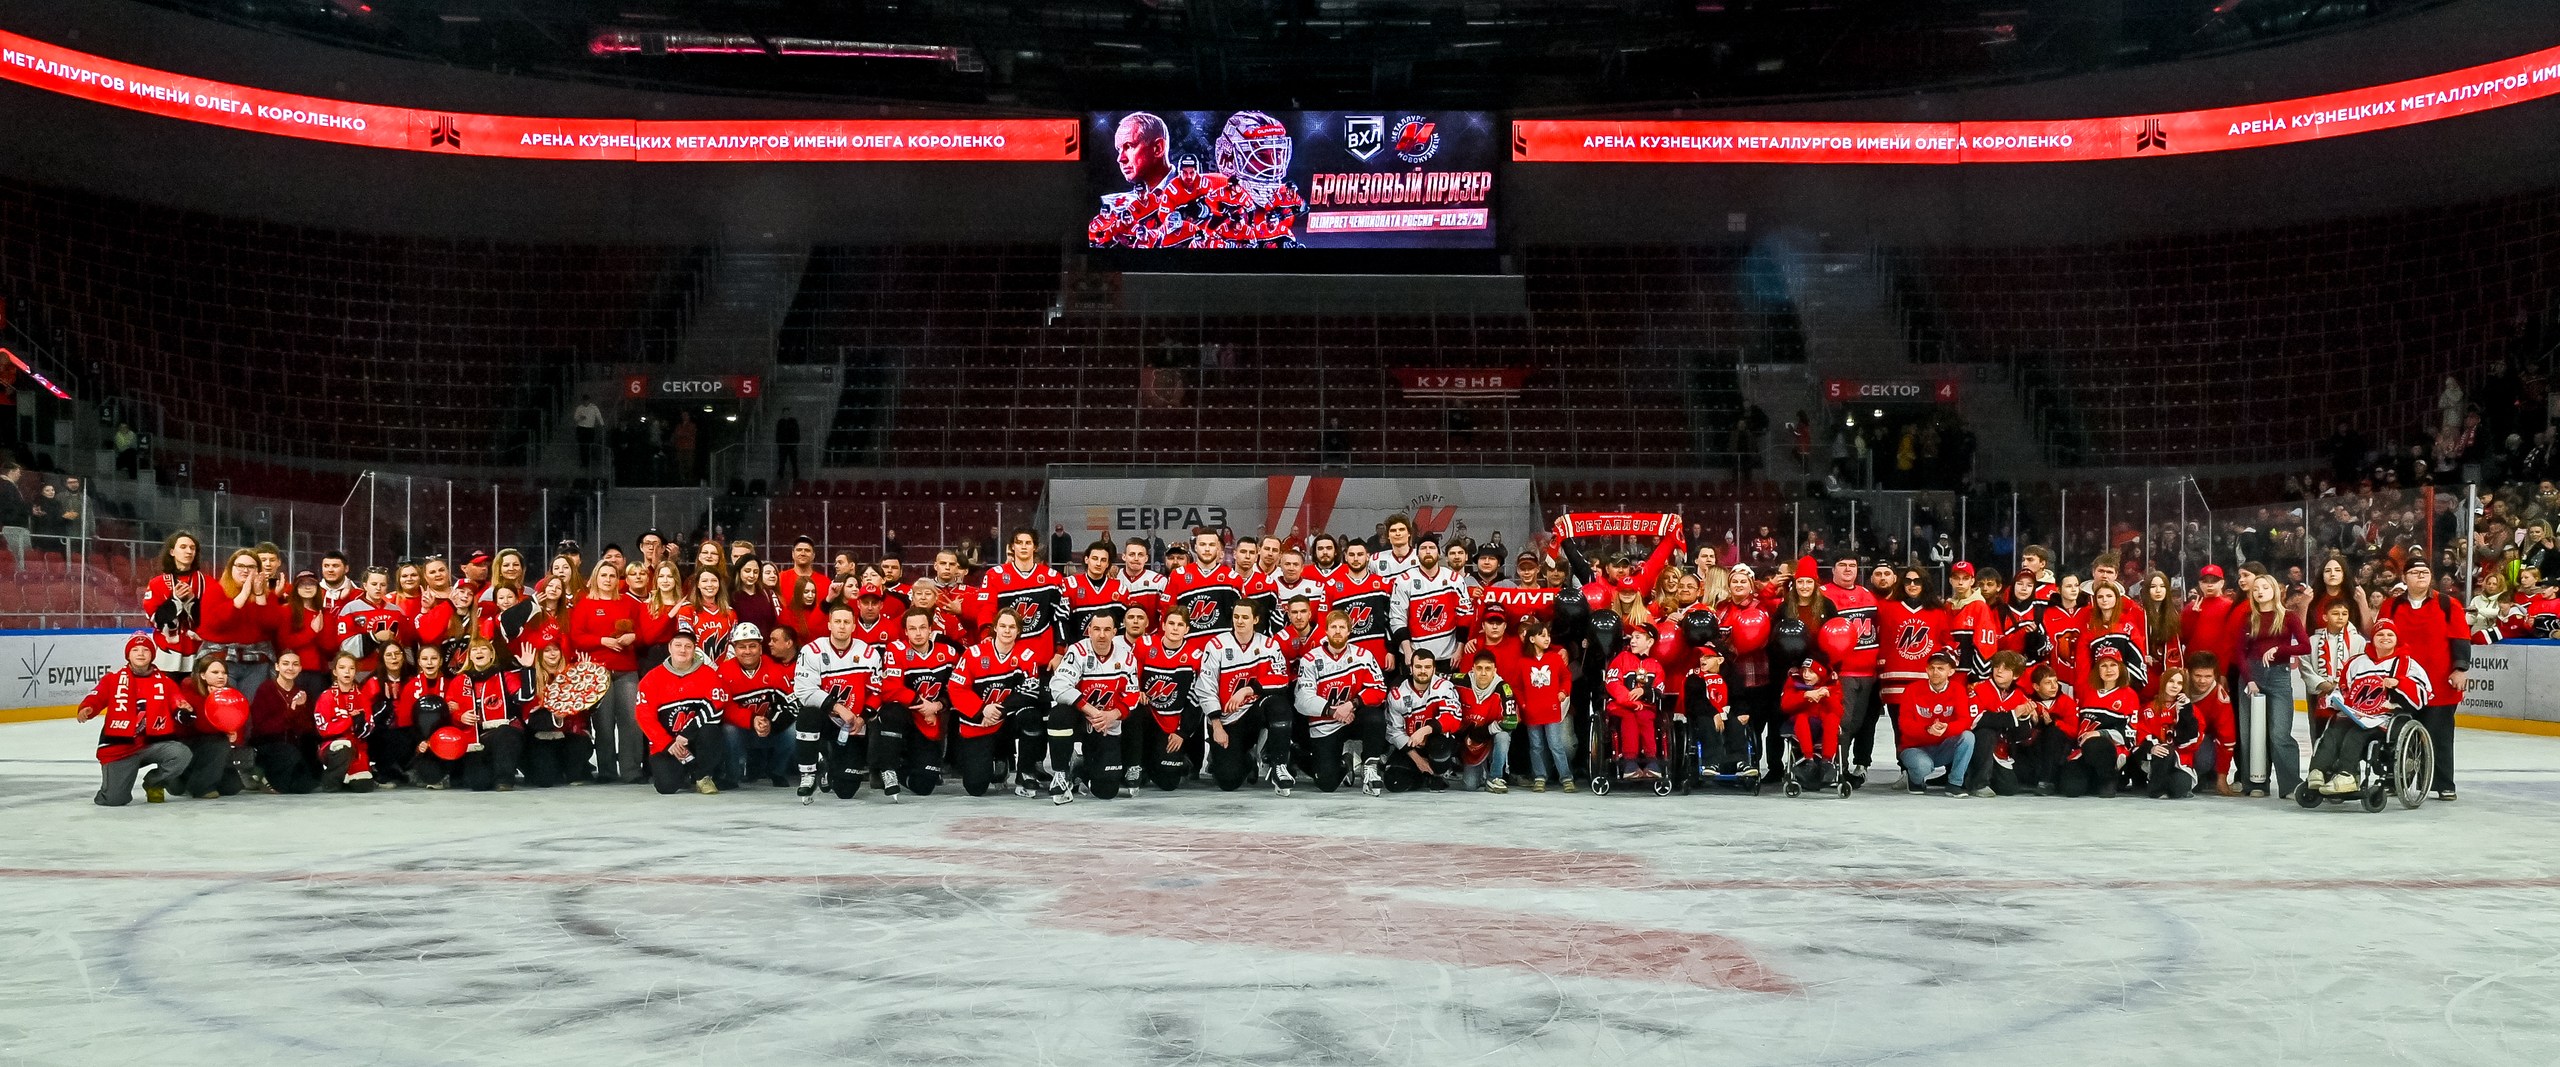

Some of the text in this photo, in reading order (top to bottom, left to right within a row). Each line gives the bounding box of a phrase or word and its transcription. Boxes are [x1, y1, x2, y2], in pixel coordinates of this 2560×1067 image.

[3, 48, 366, 131] МЕТАЛЛУРГОВ ИМЕНИ ОЛЕГА КОРОЛЕНКО
[2228, 115, 2287, 136] АРЕНА
[2291, 100, 2396, 129] КУЗНЕЦКИХ
[2401, 73, 2529, 112] МЕТАЛЛУРГОВ
[1391, 115, 1426, 142] МЕТАЛЛУРГ
[521, 133, 1005, 151] АРЕНА КУЗНЕЦКИХ МЕТАЛЛУРГОВ ИМЕНИ ОЛЕГА КОРОЛЕНКО
[1349, 129, 1381, 148] ВХЛ
[1584, 133, 2073, 150] АРЕНА КУЗНЕЦКИХ МЕТАЛЛУРГОВ ИМЕНИ ОЛЕГА КОРОЛЕНКО
[1310, 167, 1492, 206] БРОНЗОВЫЙ ПРИЗЕР
[631, 380, 752, 394] 6 СЕКТОР 5
[1417, 376, 1502, 388] КУЗНЯ
[1831, 384, 1951, 397] 5 СЕКТОР 4
[1402, 493, 1446, 516] ТАЛЛУРГ
[1117, 507, 1228, 530] ЕВРАЗ
[1575, 520, 1658, 532] МЕТАЛЛУРГ
[1009, 596, 1033, 609] ТАЛЛУРГ
[1484, 590, 1554, 604] АЛЛУР
[695, 621, 722, 643] МАНДА
[1981, 628, 1994, 645] 10
[2469, 657, 2509, 671] нецких
[1082, 683, 1109, 696] ЕТАЛЛУРГ
[1228, 672, 1249, 692] МЕТАЛЛУР
[109, 719, 130, 729] 1949
